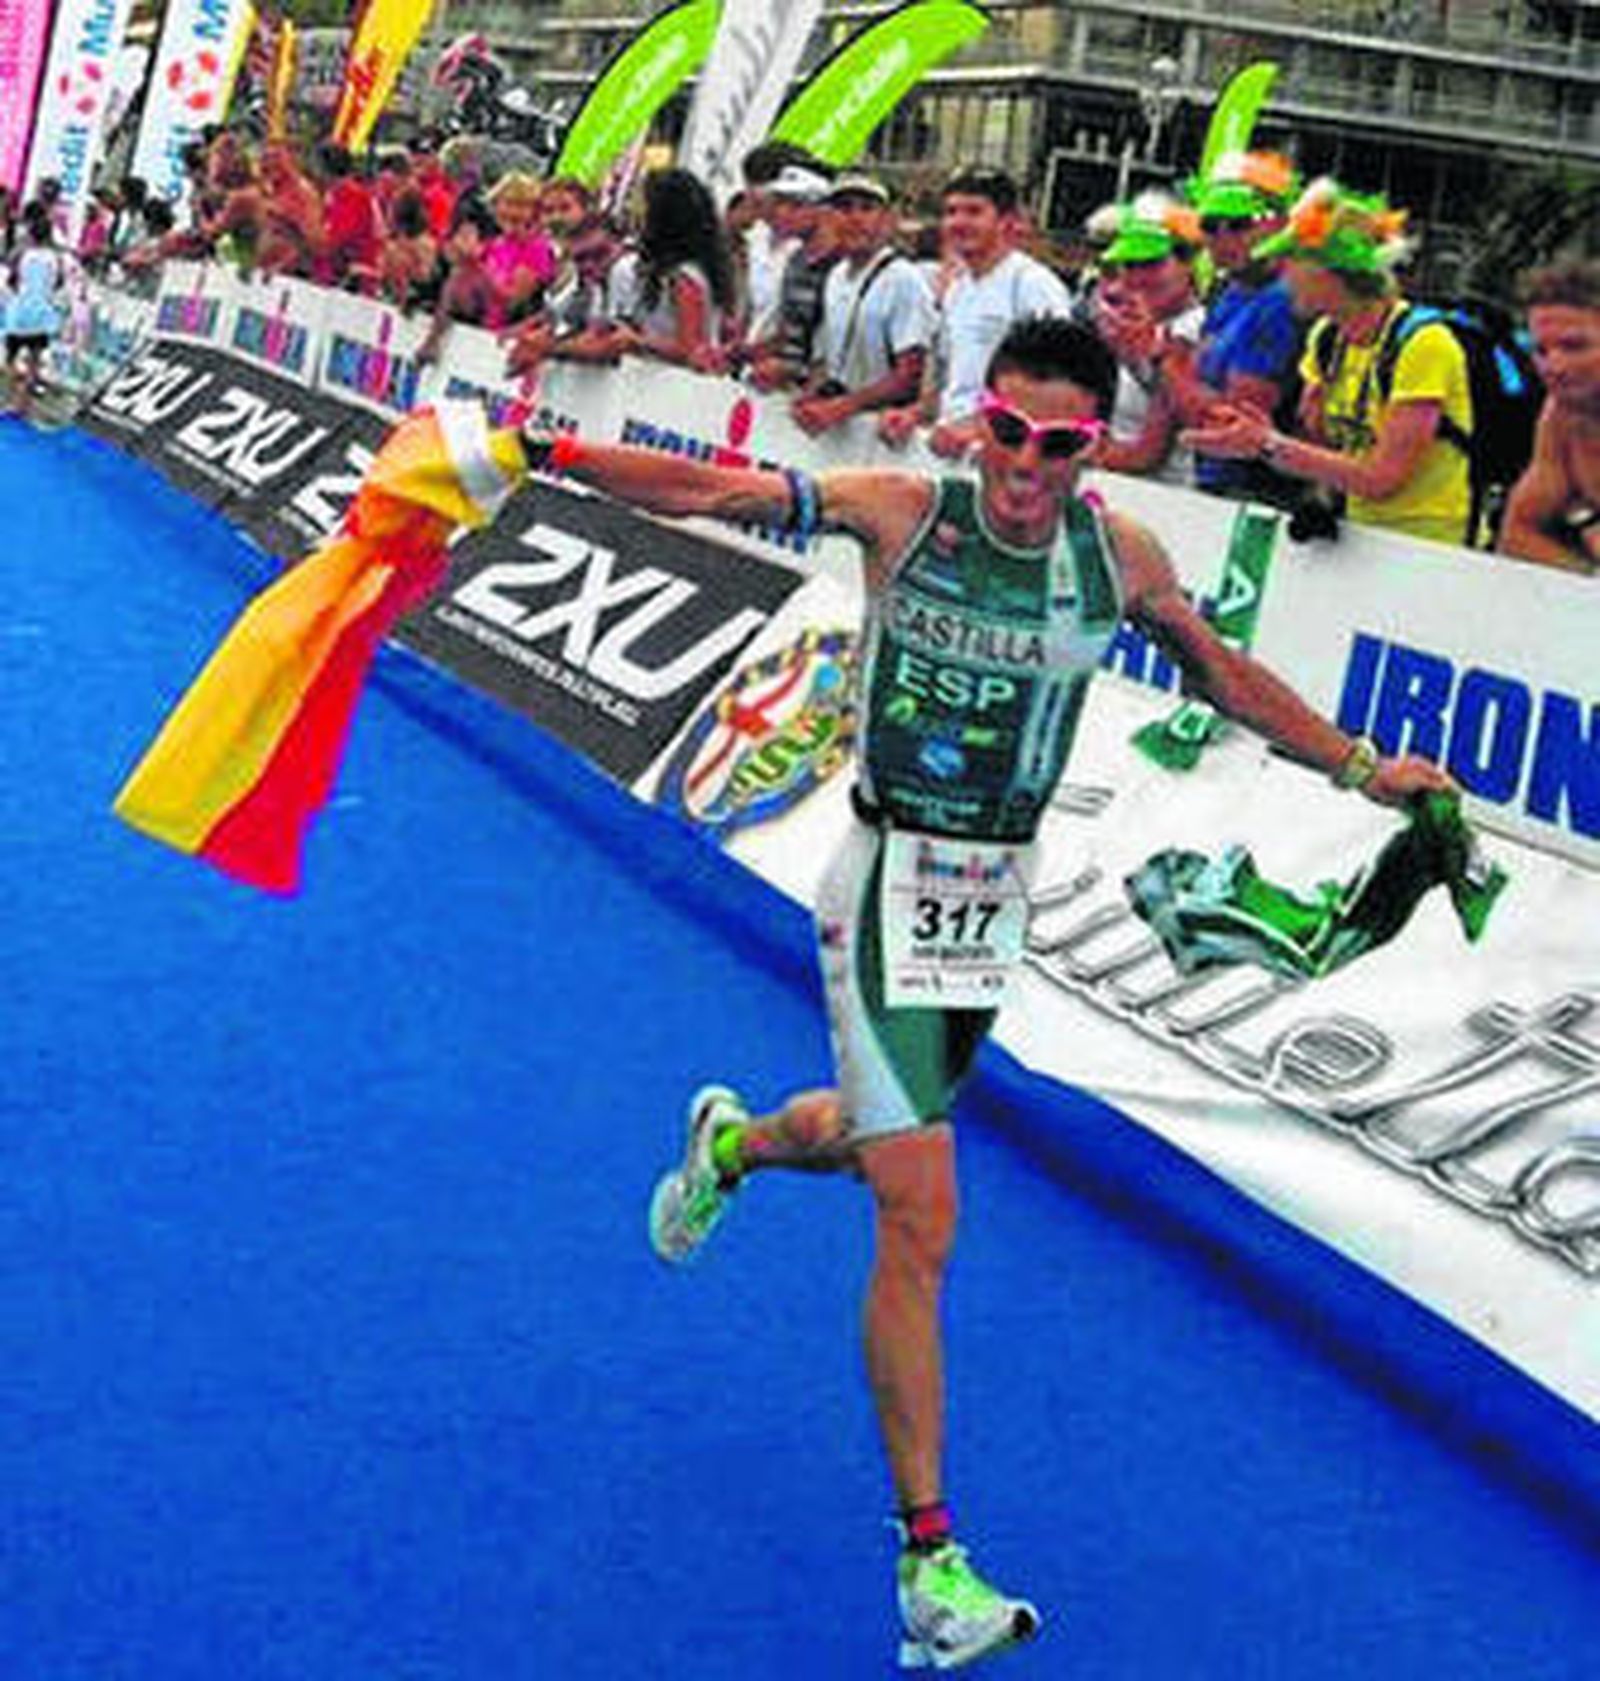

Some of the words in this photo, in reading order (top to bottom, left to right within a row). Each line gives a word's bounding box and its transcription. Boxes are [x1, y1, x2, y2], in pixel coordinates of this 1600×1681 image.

[102, 358, 213, 424] 2XU
[175, 387, 329, 485] 2XU
[451, 522, 769, 700] 2XU
[882, 597, 1046, 666] CASTILLA
[896, 649, 1017, 711] ESP
[1336, 631, 1600, 842] IRON
[912, 897, 1000, 943] 317
